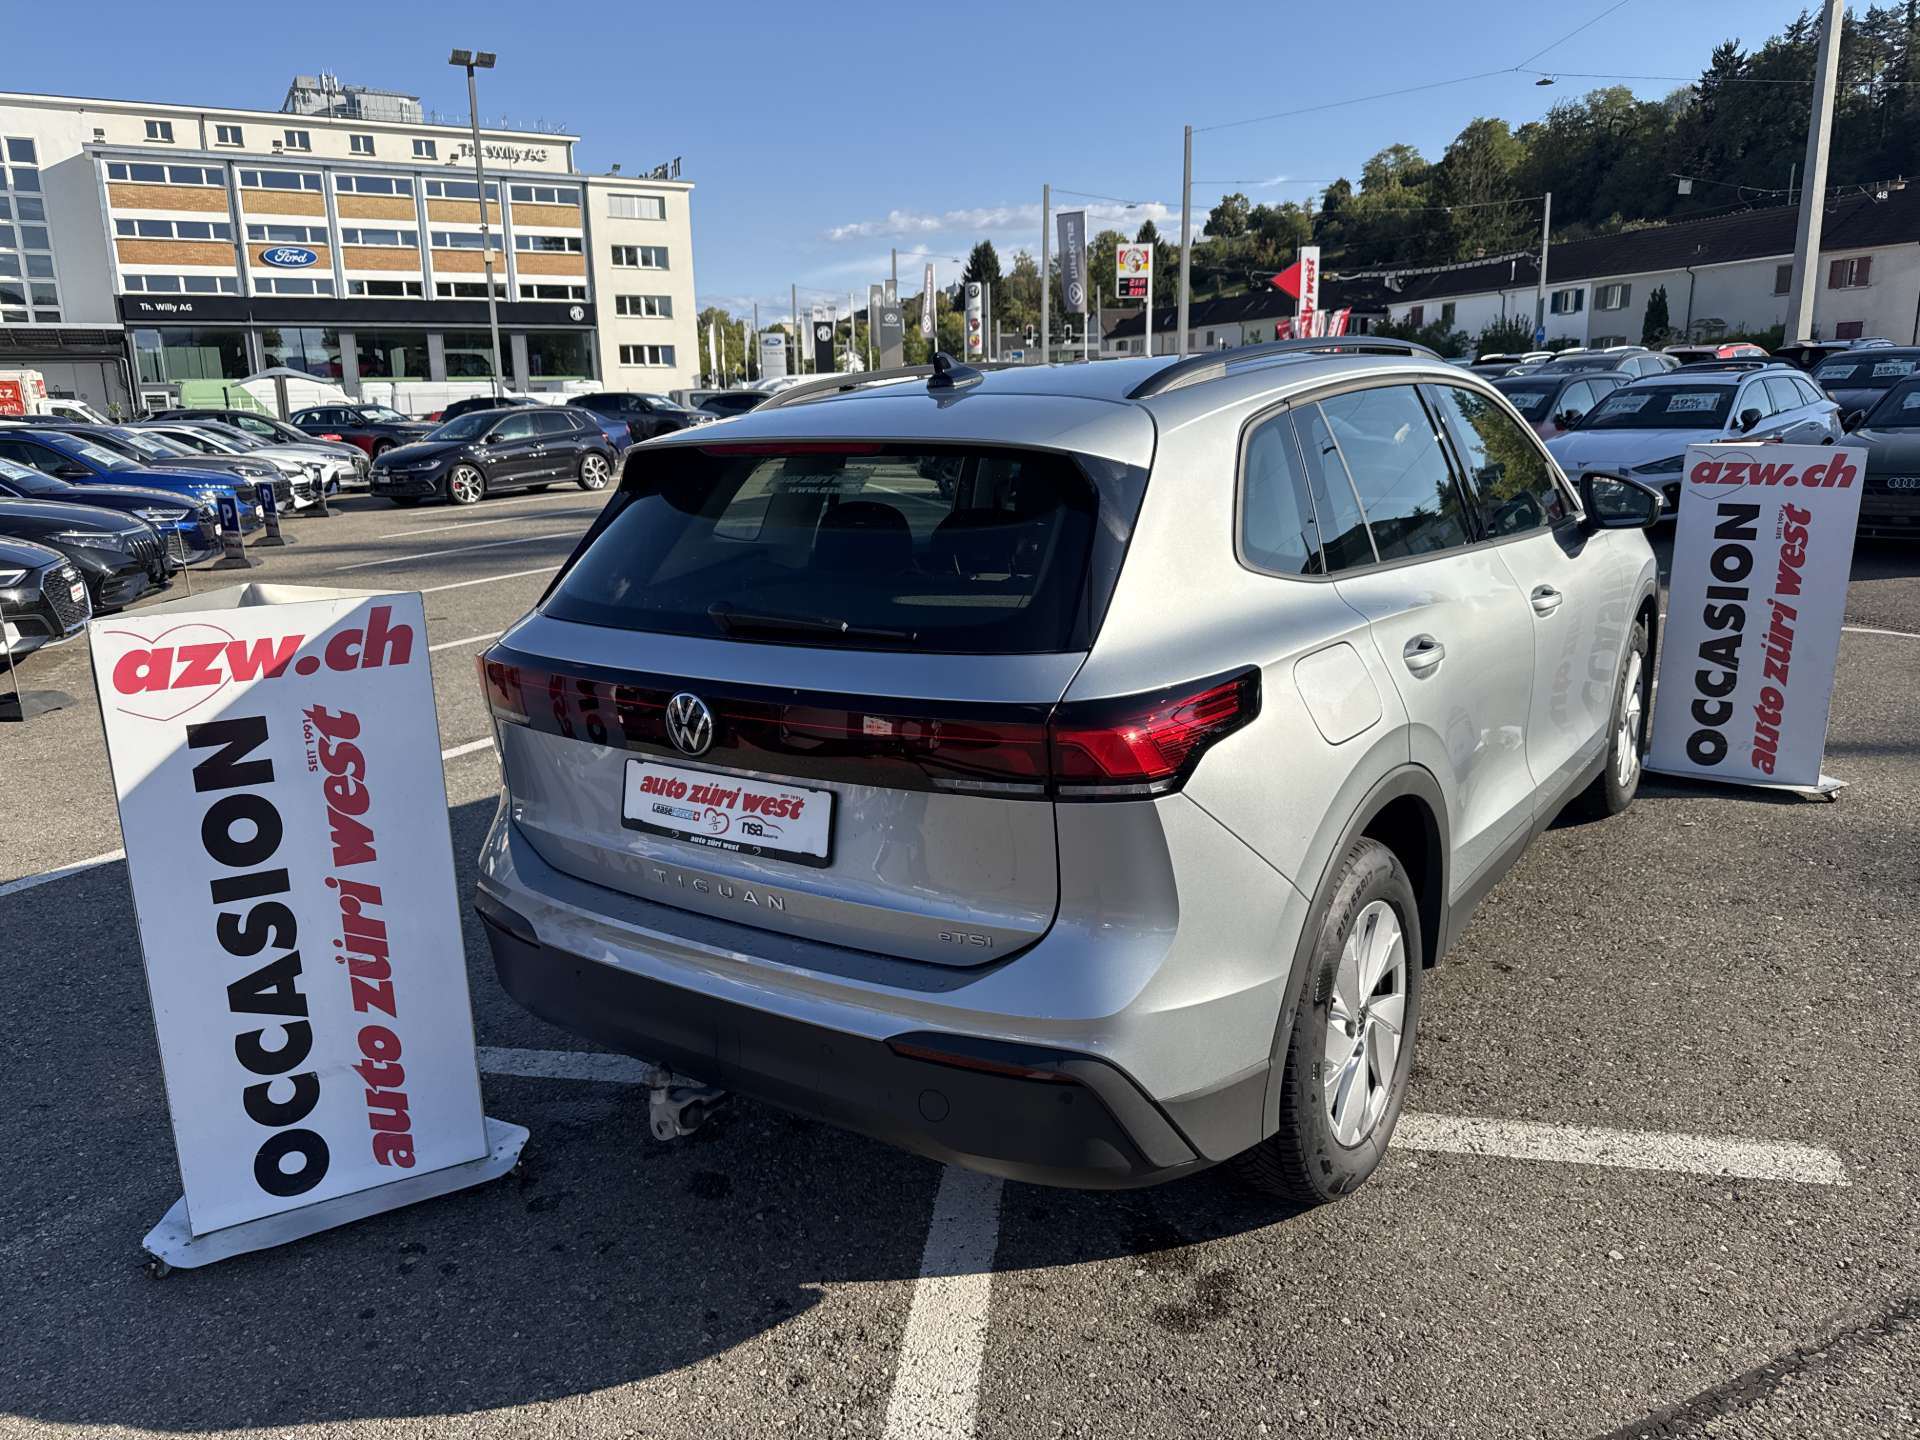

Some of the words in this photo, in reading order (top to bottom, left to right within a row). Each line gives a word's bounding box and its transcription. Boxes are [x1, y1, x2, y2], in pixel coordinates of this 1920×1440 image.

[1876, 190, 1888, 200] 48
[274, 249, 307, 264] Ford
[140, 303, 153, 312] Th.
[155, 303, 177, 313] Willy
[179, 304, 193, 312] AG
[1690, 453, 1857, 489] azw.ch
[222, 503, 232, 527] P
[262, 489, 271, 508] P
[1775, 502, 1812, 595] west
[113, 605, 414, 695] azw.ch
[1686, 503, 1761, 767] OCCASION
[1760, 598, 1798, 687] züri
[302, 719, 314, 745] 1991
[1751, 686, 1785, 775] auto
[306, 749, 318, 772] SEIT
[302, 703, 377, 868] west
[640, 775, 688, 800] auto
[687, 782, 741, 809] züri
[742, 792, 806, 820] west
[690, 834, 706, 845] auto
[707, 837, 722, 848] züri
[723, 841, 740, 852] west
[742, 821, 763, 837] nsa
[653, 868, 786, 911] TIGUAN
[186, 716, 330, 1197] OCCASION
[324, 876, 397, 1018] züri
[938, 931, 993, 948] eTSI
[352, 1025, 416, 1169] auto
